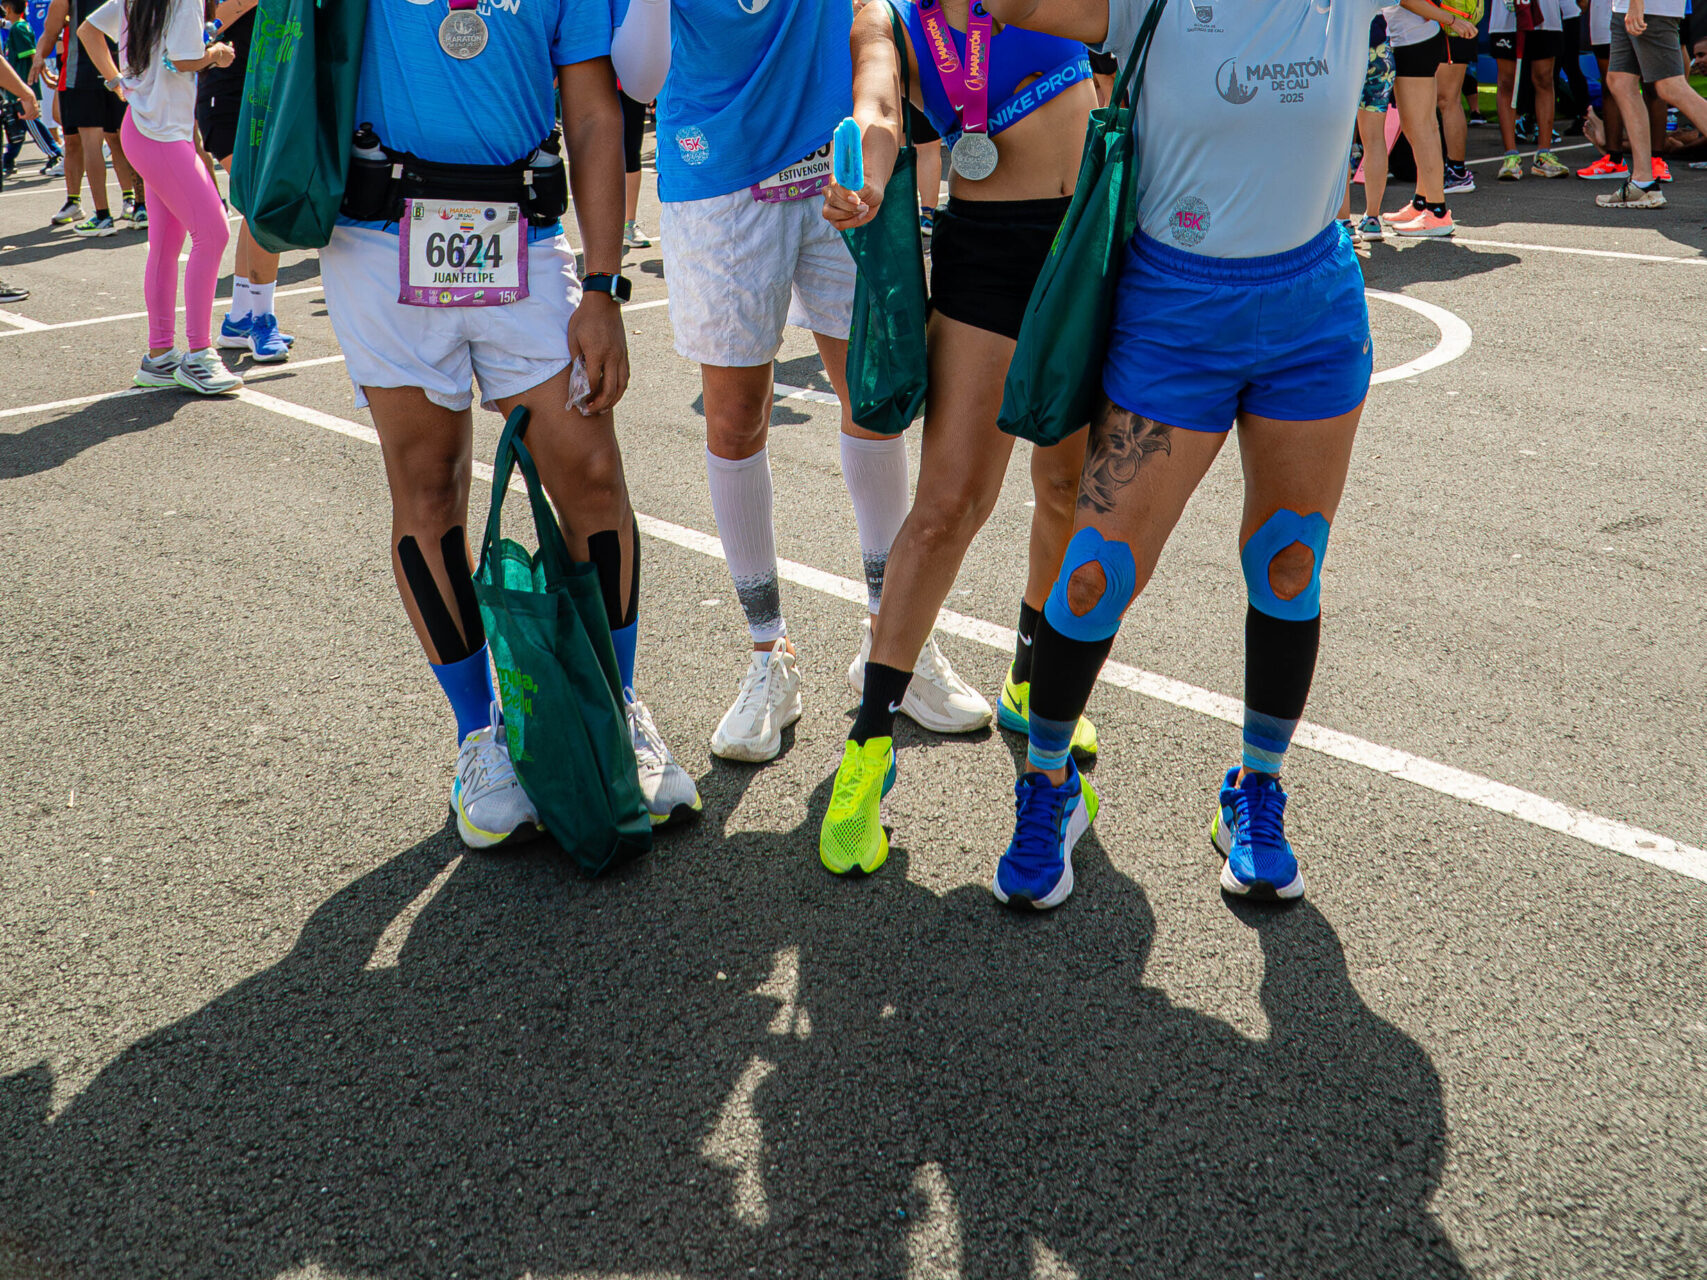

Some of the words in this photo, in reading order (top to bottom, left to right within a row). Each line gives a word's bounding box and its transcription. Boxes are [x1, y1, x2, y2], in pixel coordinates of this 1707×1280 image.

[969, 29, 981, 76] MARATÓN
[1246, 56, 1329, 81] MARATÓN
[1271, 80, 1285, 91] DE
[1286, 78, 1309, 90] CALI
[988, 91, 1035, 132] NIKE
[1035, 65, 1077, 100] PRO
[1280, 92, 1304, 104] 2025
[679, 138, 704, 152] 15K
[778, 162, 830, 182] ESTIVENSON
[1175, 211, 1204, 231] 15K
[426, 232, 503, 268] 6624
[433, 272, 459, 283] JUAN
[461, 272, 495, 284] FELIPE
[499, 291, 517, 303] 15K
